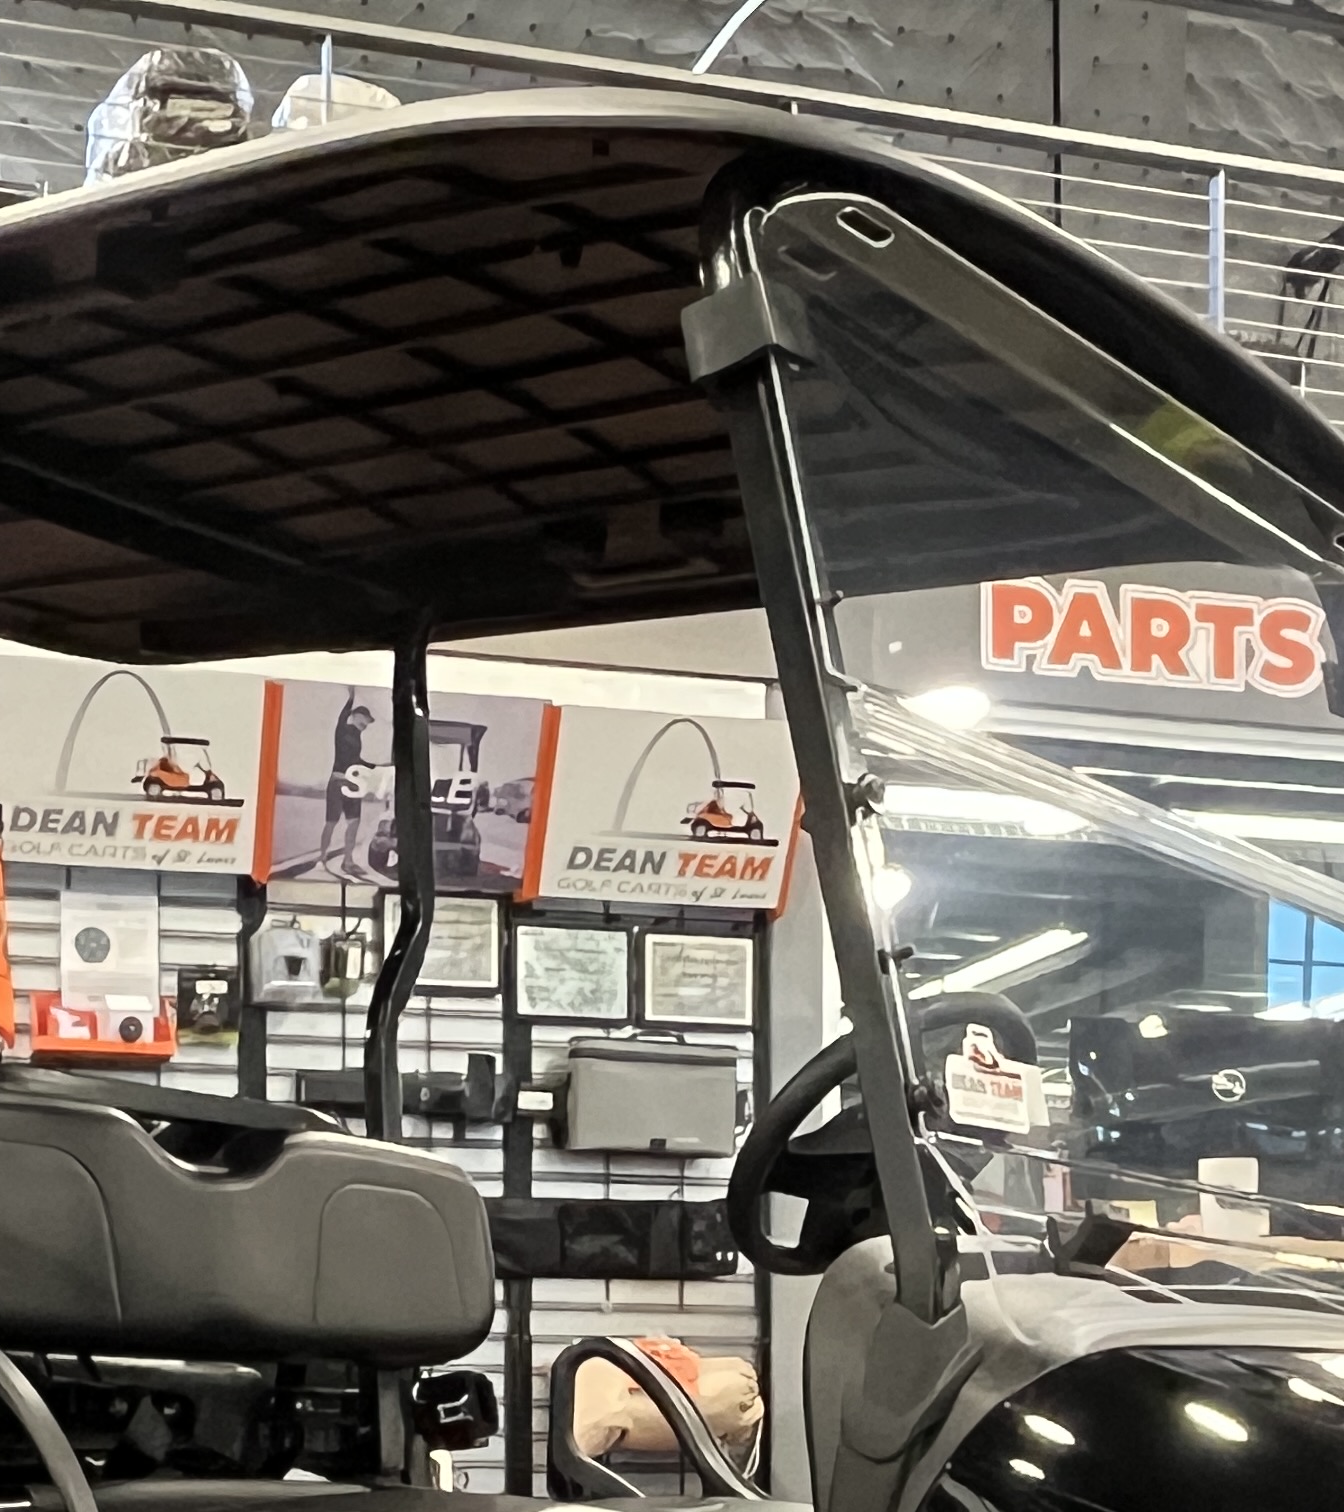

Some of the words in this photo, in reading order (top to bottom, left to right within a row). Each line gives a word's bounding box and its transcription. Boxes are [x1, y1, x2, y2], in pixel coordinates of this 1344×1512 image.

[986, 580, 1320, 690] PARTS
[9, 805, 121, 837] DEAN
[131, 812, 242, 845] TEAM
[566, 845, 667, 875] DEAN
[676, 852, 775, 882] TEAM
